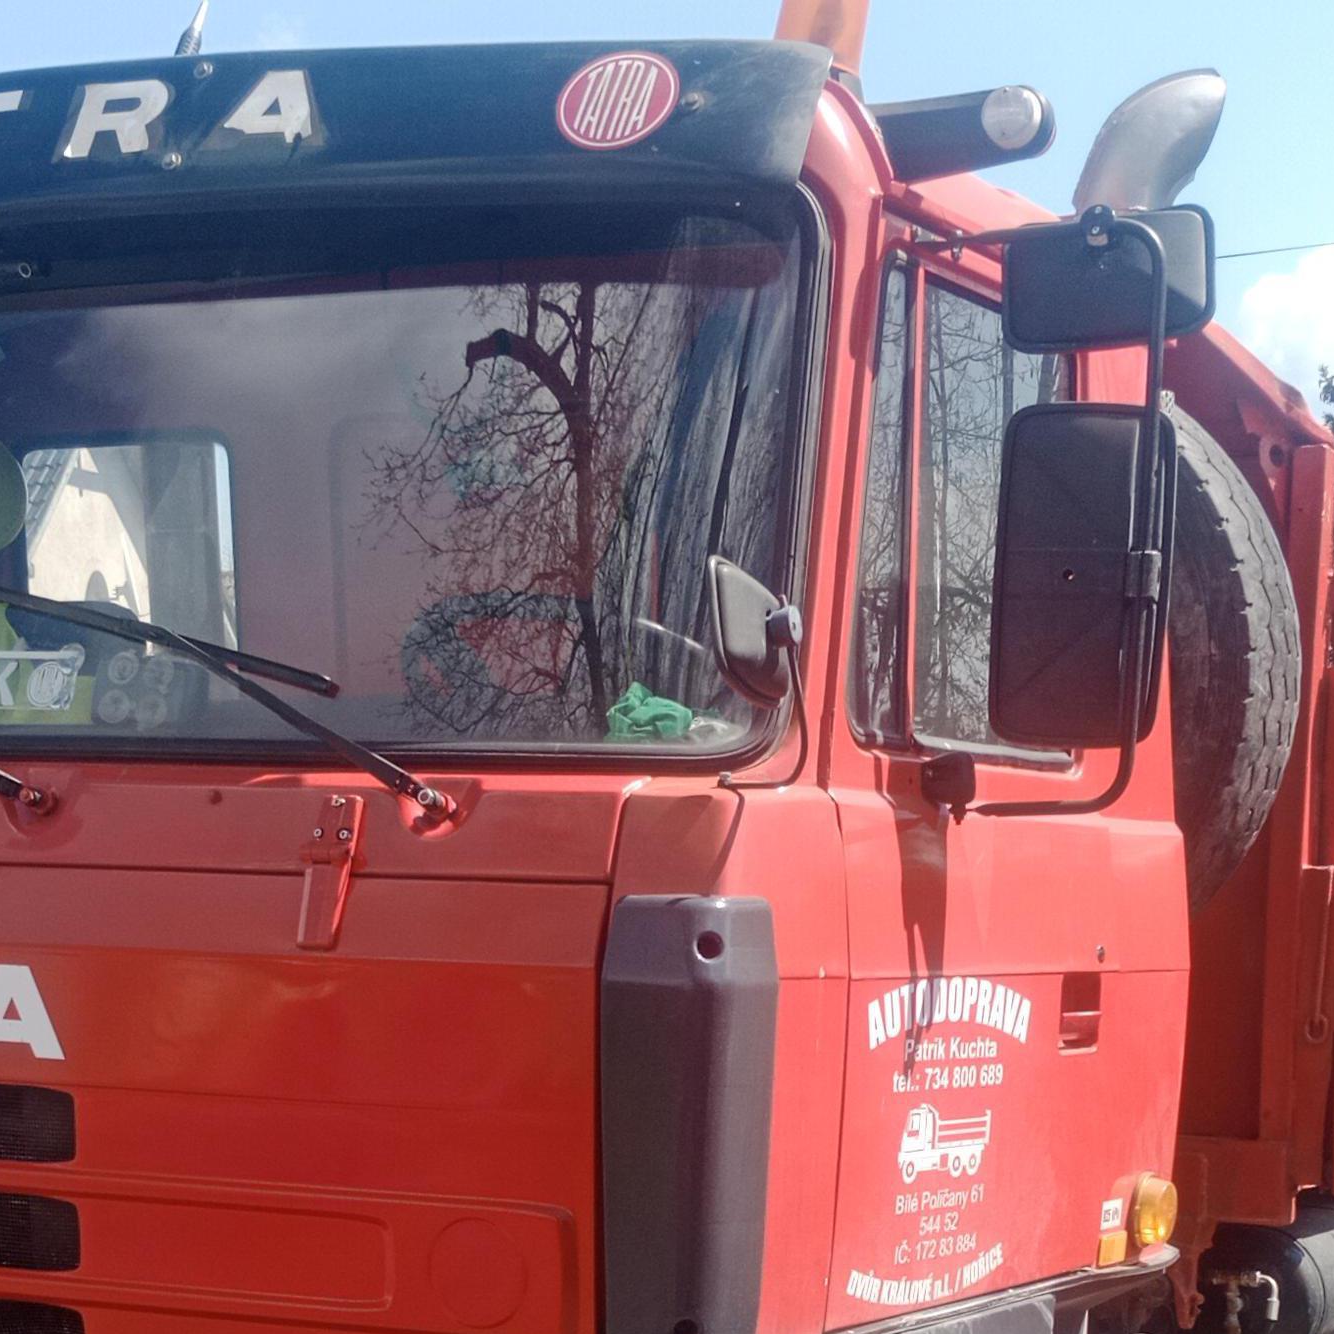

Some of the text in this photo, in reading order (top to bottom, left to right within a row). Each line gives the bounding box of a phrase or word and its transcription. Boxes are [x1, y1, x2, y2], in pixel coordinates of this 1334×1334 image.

[574, 59, 658, 141] TATRA
[868, 975, 1031, 1049] AUTODOPRAVA
[905, 1036, 998, 1062] Patrik Kuchta
[924, 1067, 949, 1090] 734
[952, 1065, 976, 1088] 800
[980, 1063, 1004, 1086] 689
[970, 1184, 985, 1204] 61
[918, 1211, 959, 1236] 544 52
[916, 1239, 937, 1261] 172
[939, 1236, 954, 1257] 83
[956, 1233, 977, 1254] 884
[880, 1272, 934, 1305] KRÁLOVÉ
